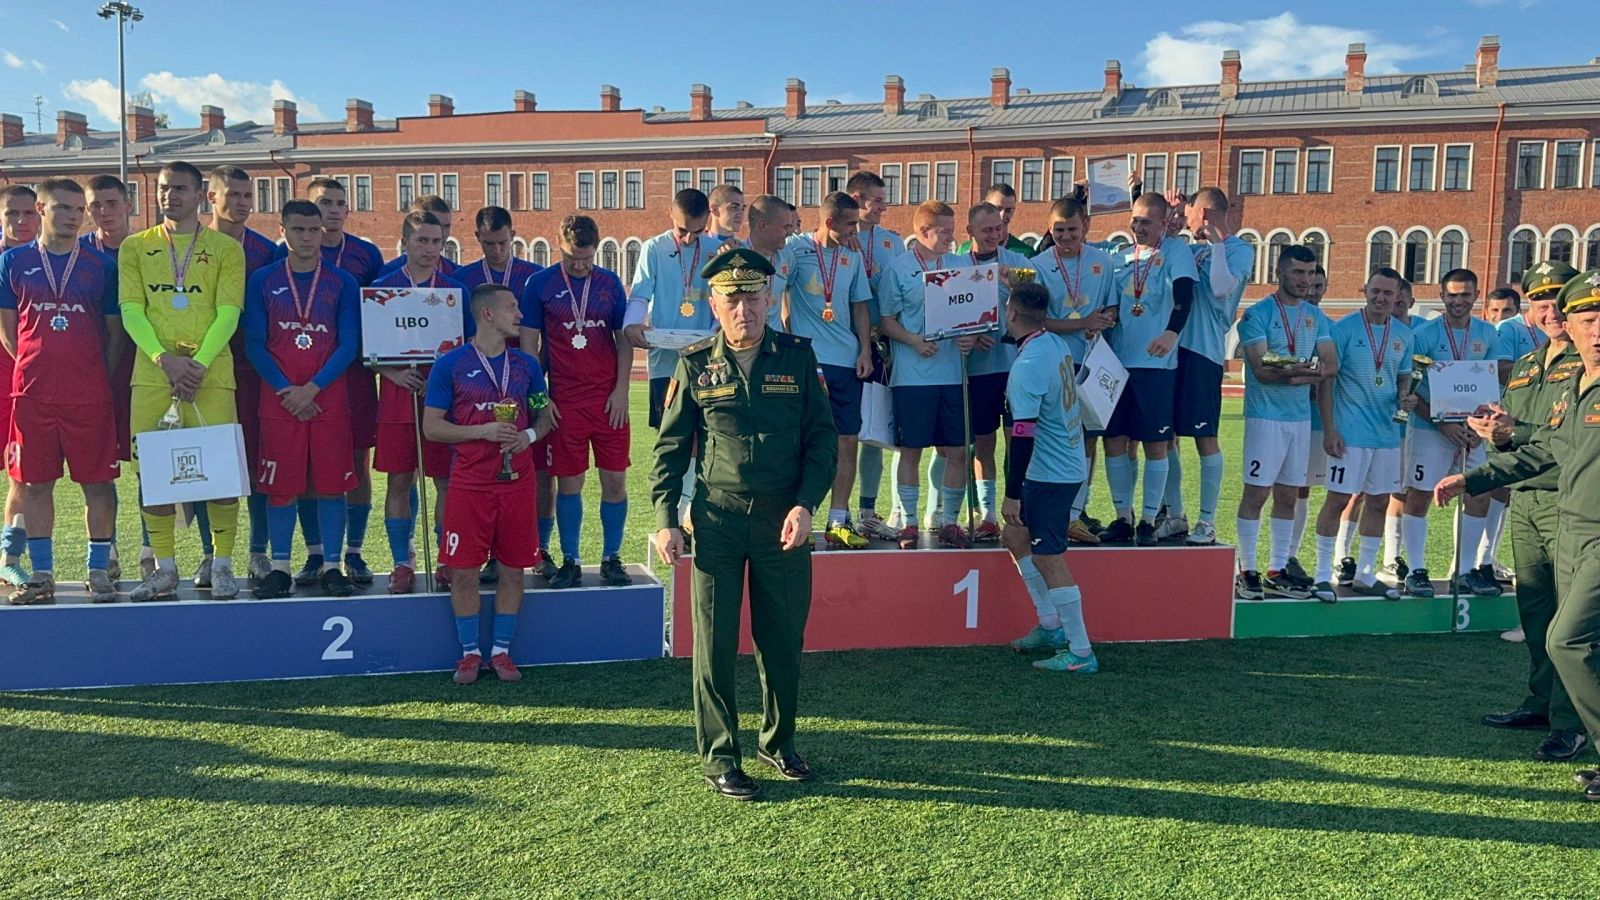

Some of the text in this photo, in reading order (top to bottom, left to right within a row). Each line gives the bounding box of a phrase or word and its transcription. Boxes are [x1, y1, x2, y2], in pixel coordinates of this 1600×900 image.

[148, 284, 203, 293] УРАЛ
[948, 292, 974, 306] МВО
[32, 302, 86, 313] УРАЛ
[277, 321, 329, 333] УРАЛ
[395, 316, 429, 329] ЦВО
[1452, 382, 1478, 394] ЮВО
[1015, 423, 1025, 435] C
[1250, 460, 1260, 477] 2
[1330, 465, 1345, 484] 11
[1414, 463, 1424, 481] 5
[446, 530, 460, 556] 19
[953, 569, 979, 630] 1
[1456, 598, 1470, 630] 3
[321, 615, 355, 661] 2
